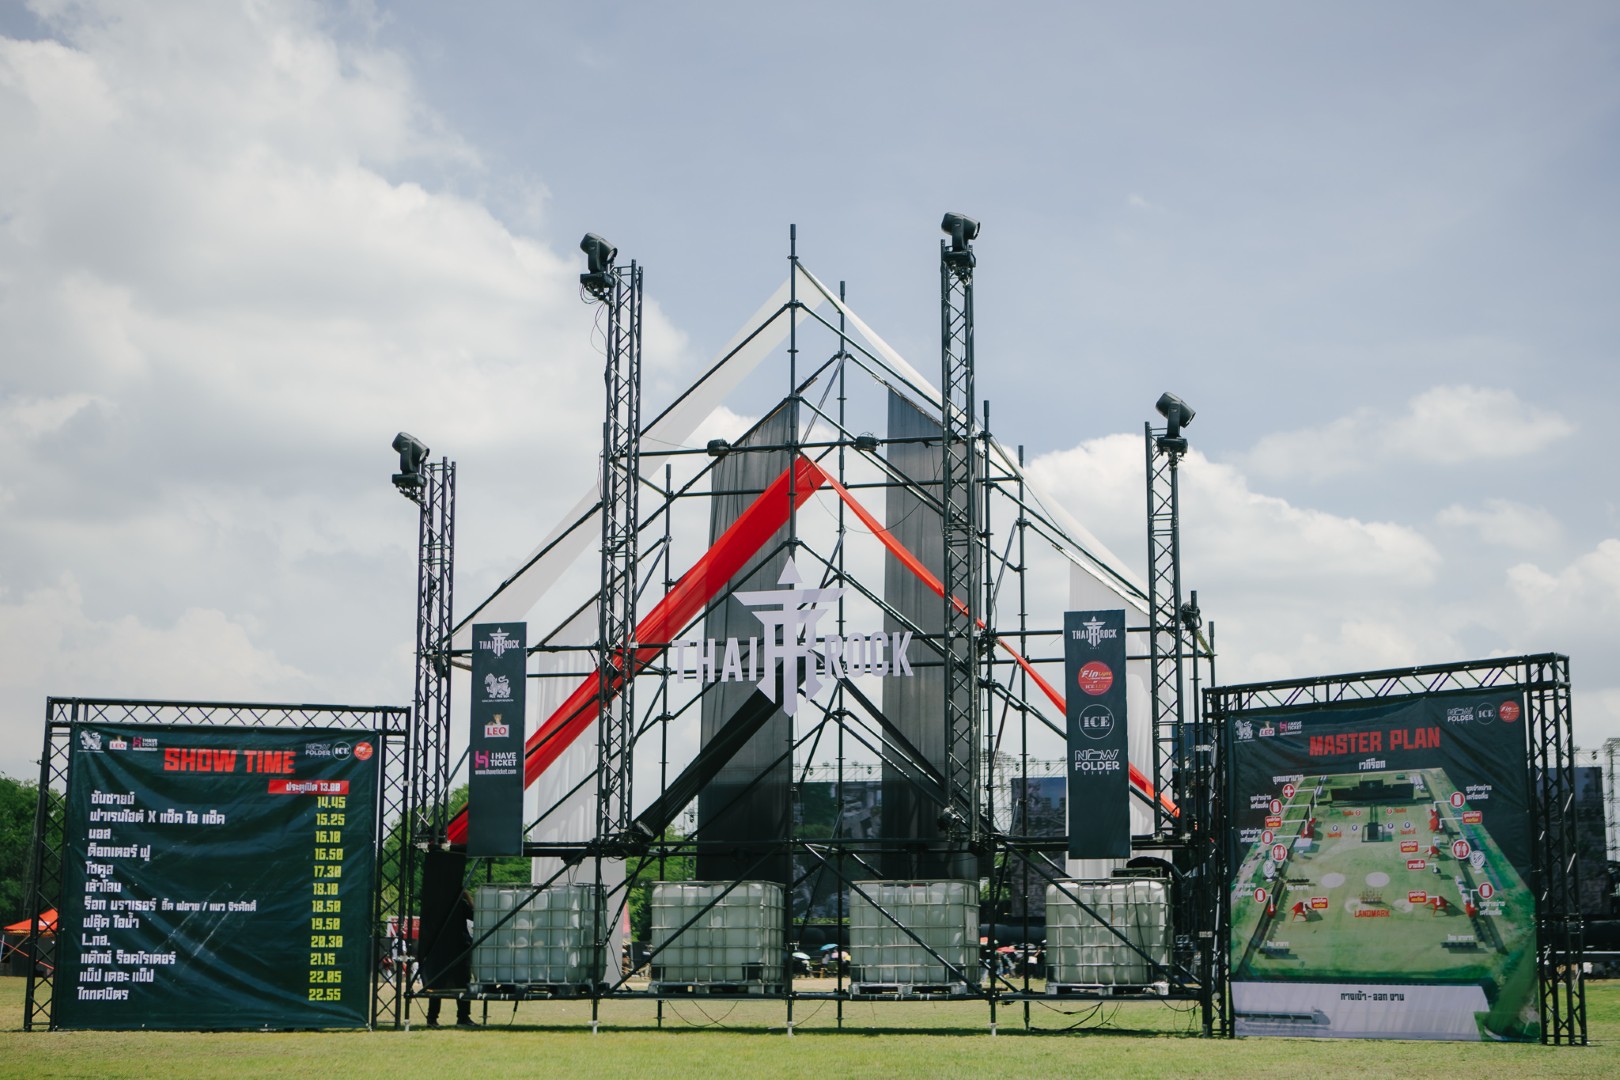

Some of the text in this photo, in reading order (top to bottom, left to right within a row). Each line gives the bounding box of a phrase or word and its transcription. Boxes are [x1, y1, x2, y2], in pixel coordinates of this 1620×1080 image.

[1072, 629, 1117, 640] THAI ROCK
[479, 639, 520, 650] THAI ROCK
[672, 631, 914, 684] THAI ROCK
[1447, 714, 1474, 722] FOLDER
[1478, 709, 1494, 718] ICE
[1083, 715, 1110, 728] ICE
[487, 726, 507, 736] LEO
[1309, 727, 1441, 756] MASTER PLAN
[334, 747, 350, 755] ICE
[164, 748, 296, 774] SHOW TIME
[490, 759, 517, 767] TICKET
[1075, 761, 1120, 771] FOLDER
[317, 796, 346, 809] 14.45
[147, 810, 156, 823] X
[316, 813, 345, 826] 15.25
[315, 831, 341, 843] 16.10
[313, 865, 342, 878] 17.30
[313, 883, 338, 895] 18.10
[312, 900, 341, 912] 18.50
[1354, 909, 1390, 918] LANDMARK
[311, 918, 340, 930] 19.50
[311, 935, 343, 948] 20.30
[310, 953, 335, 965] 21.15
[309, 970, 342, 983] 22.05
[308, 988, 341, 1001] 22.55
